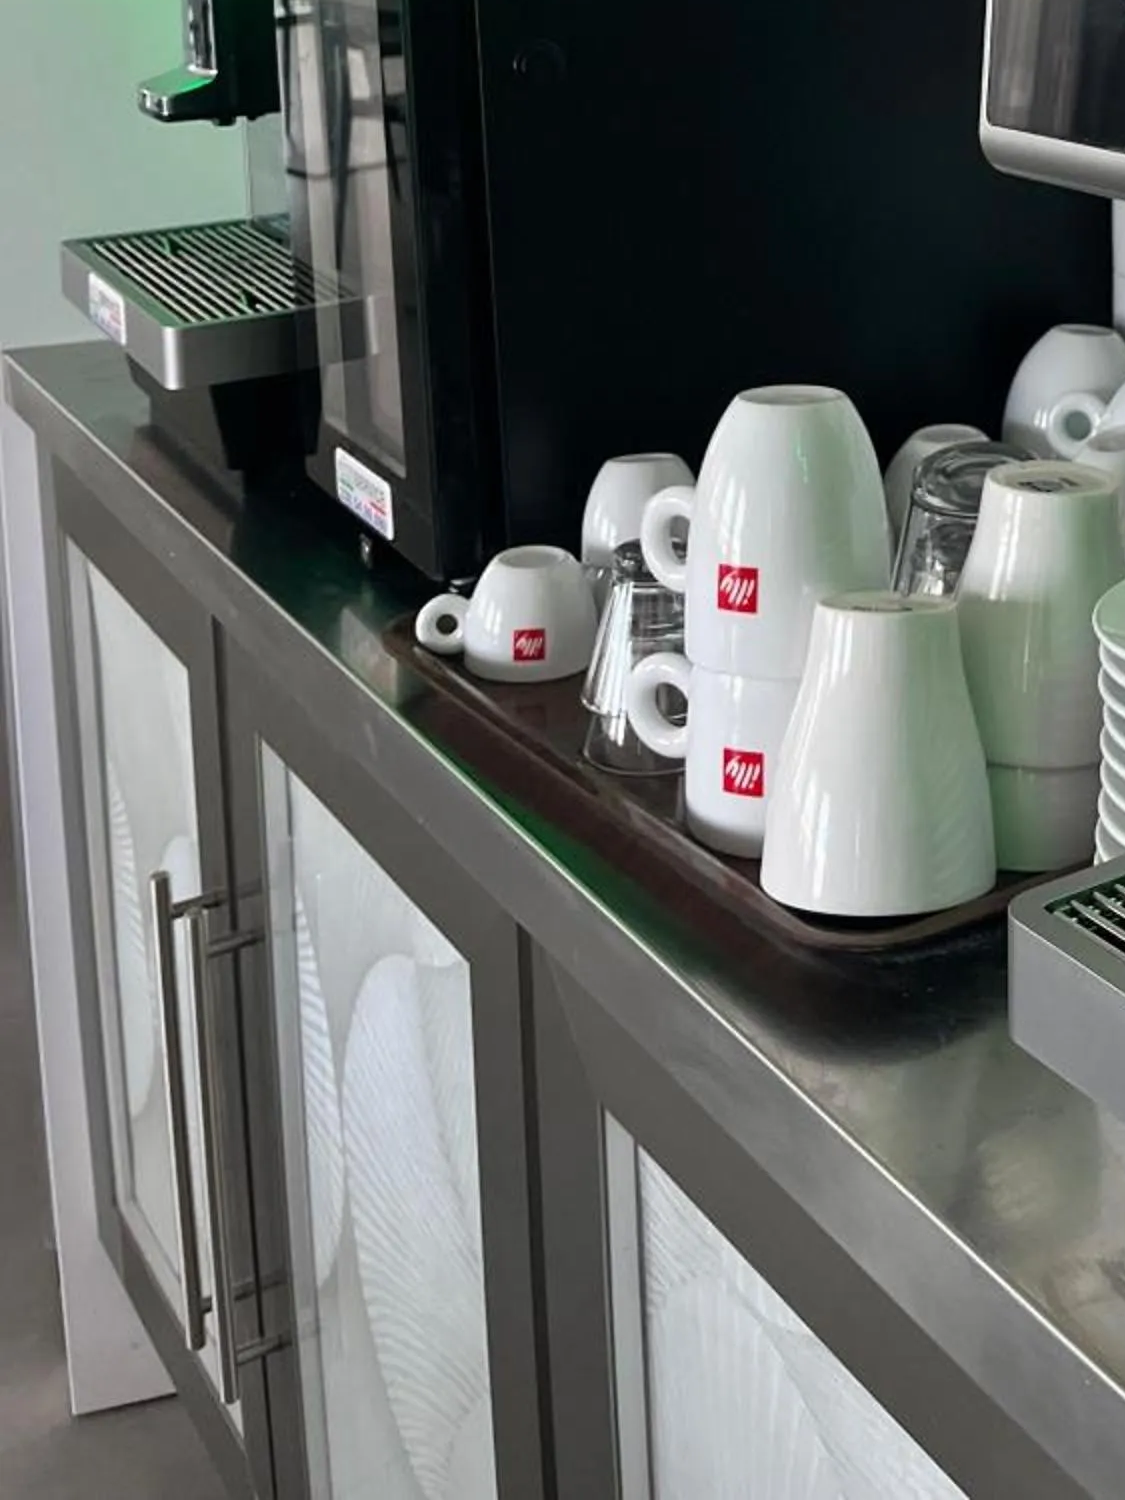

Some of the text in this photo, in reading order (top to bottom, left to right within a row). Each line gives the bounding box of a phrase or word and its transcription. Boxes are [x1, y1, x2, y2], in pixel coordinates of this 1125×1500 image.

[719, 569, 755, 607] illy
[514, 632, 543, 657] illy
[724, 754, 761, 790] illy
